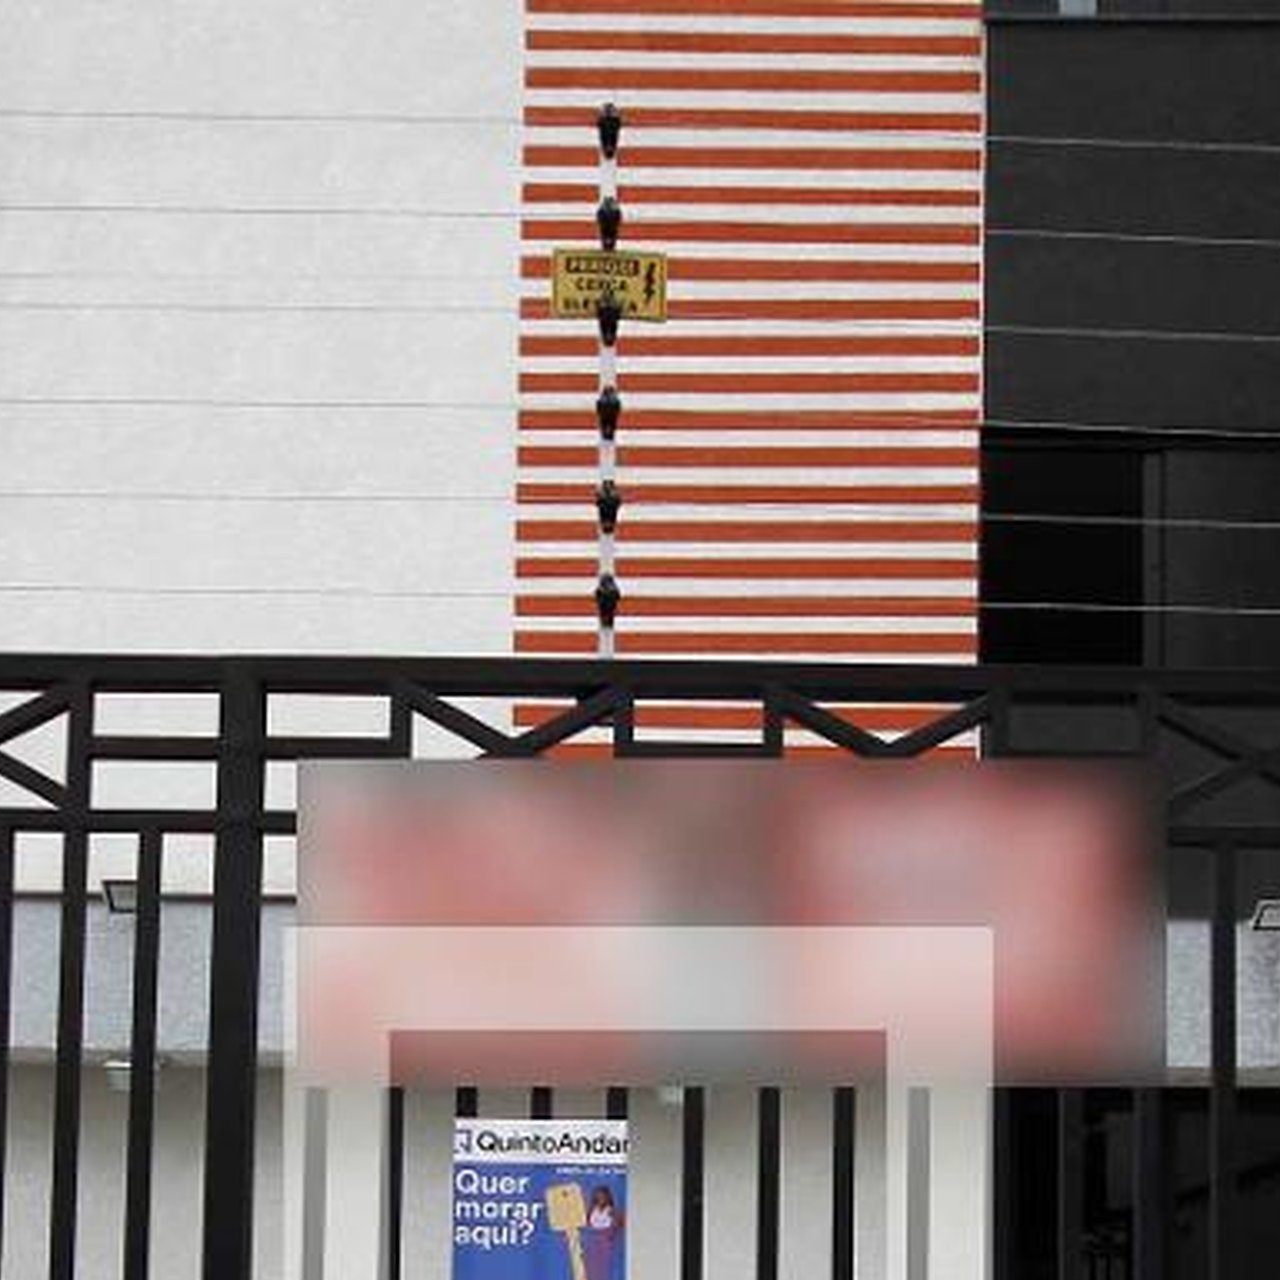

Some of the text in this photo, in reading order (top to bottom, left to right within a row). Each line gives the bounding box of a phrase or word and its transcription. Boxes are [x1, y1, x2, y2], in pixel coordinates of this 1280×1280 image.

[476, 1131, 628, 1154] QuintoAndar
[455, 1168, 530, 1195] Quer
[455, 1201, 544, 1219] morar
[455, 1219, 535, 1249] aqui?
